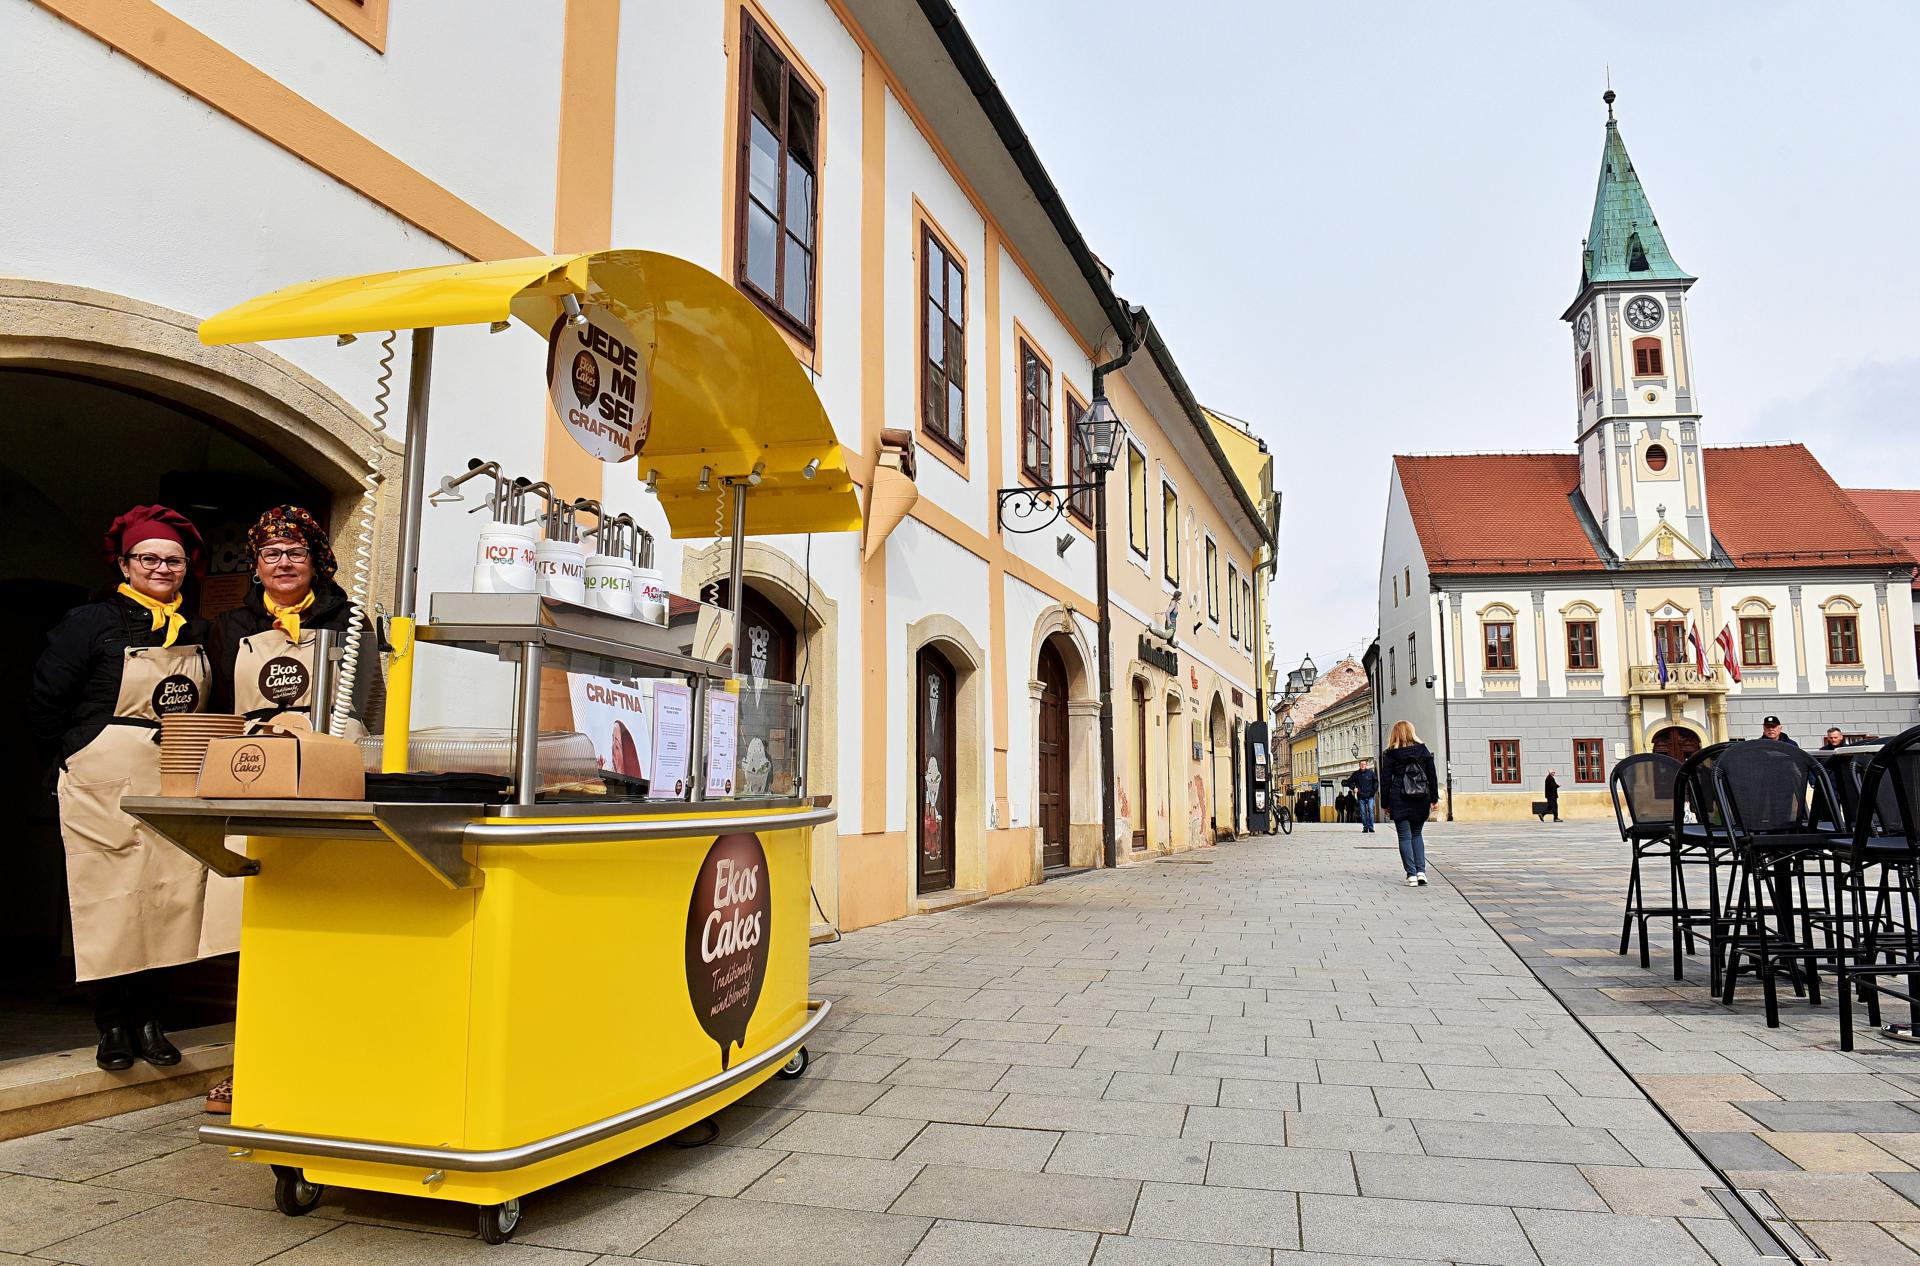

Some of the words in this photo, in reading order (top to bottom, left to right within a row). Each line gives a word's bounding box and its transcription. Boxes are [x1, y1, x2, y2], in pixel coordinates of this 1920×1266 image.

[578, 323, 637, 376] JEDE
[610, 367, 637, 404] MI
[598, 391, 634, 432] SE!
[568, 408, 631, 452] CRAFTNA
[265, 674, 303, 688] Cakes
[270, 664, 298, 676] Ekos
[158, 692, 193, 706] Cakes
[164, 681, 190, 694] Ekos
[586, 683, 643, 714] CRAFTNA
[233, 762, 262, 773] Cakes
[239, 752, 261, 763] Ekos
[714, 858, 758, 909] Ekos
[702, 908, 762, 963] Cakes
